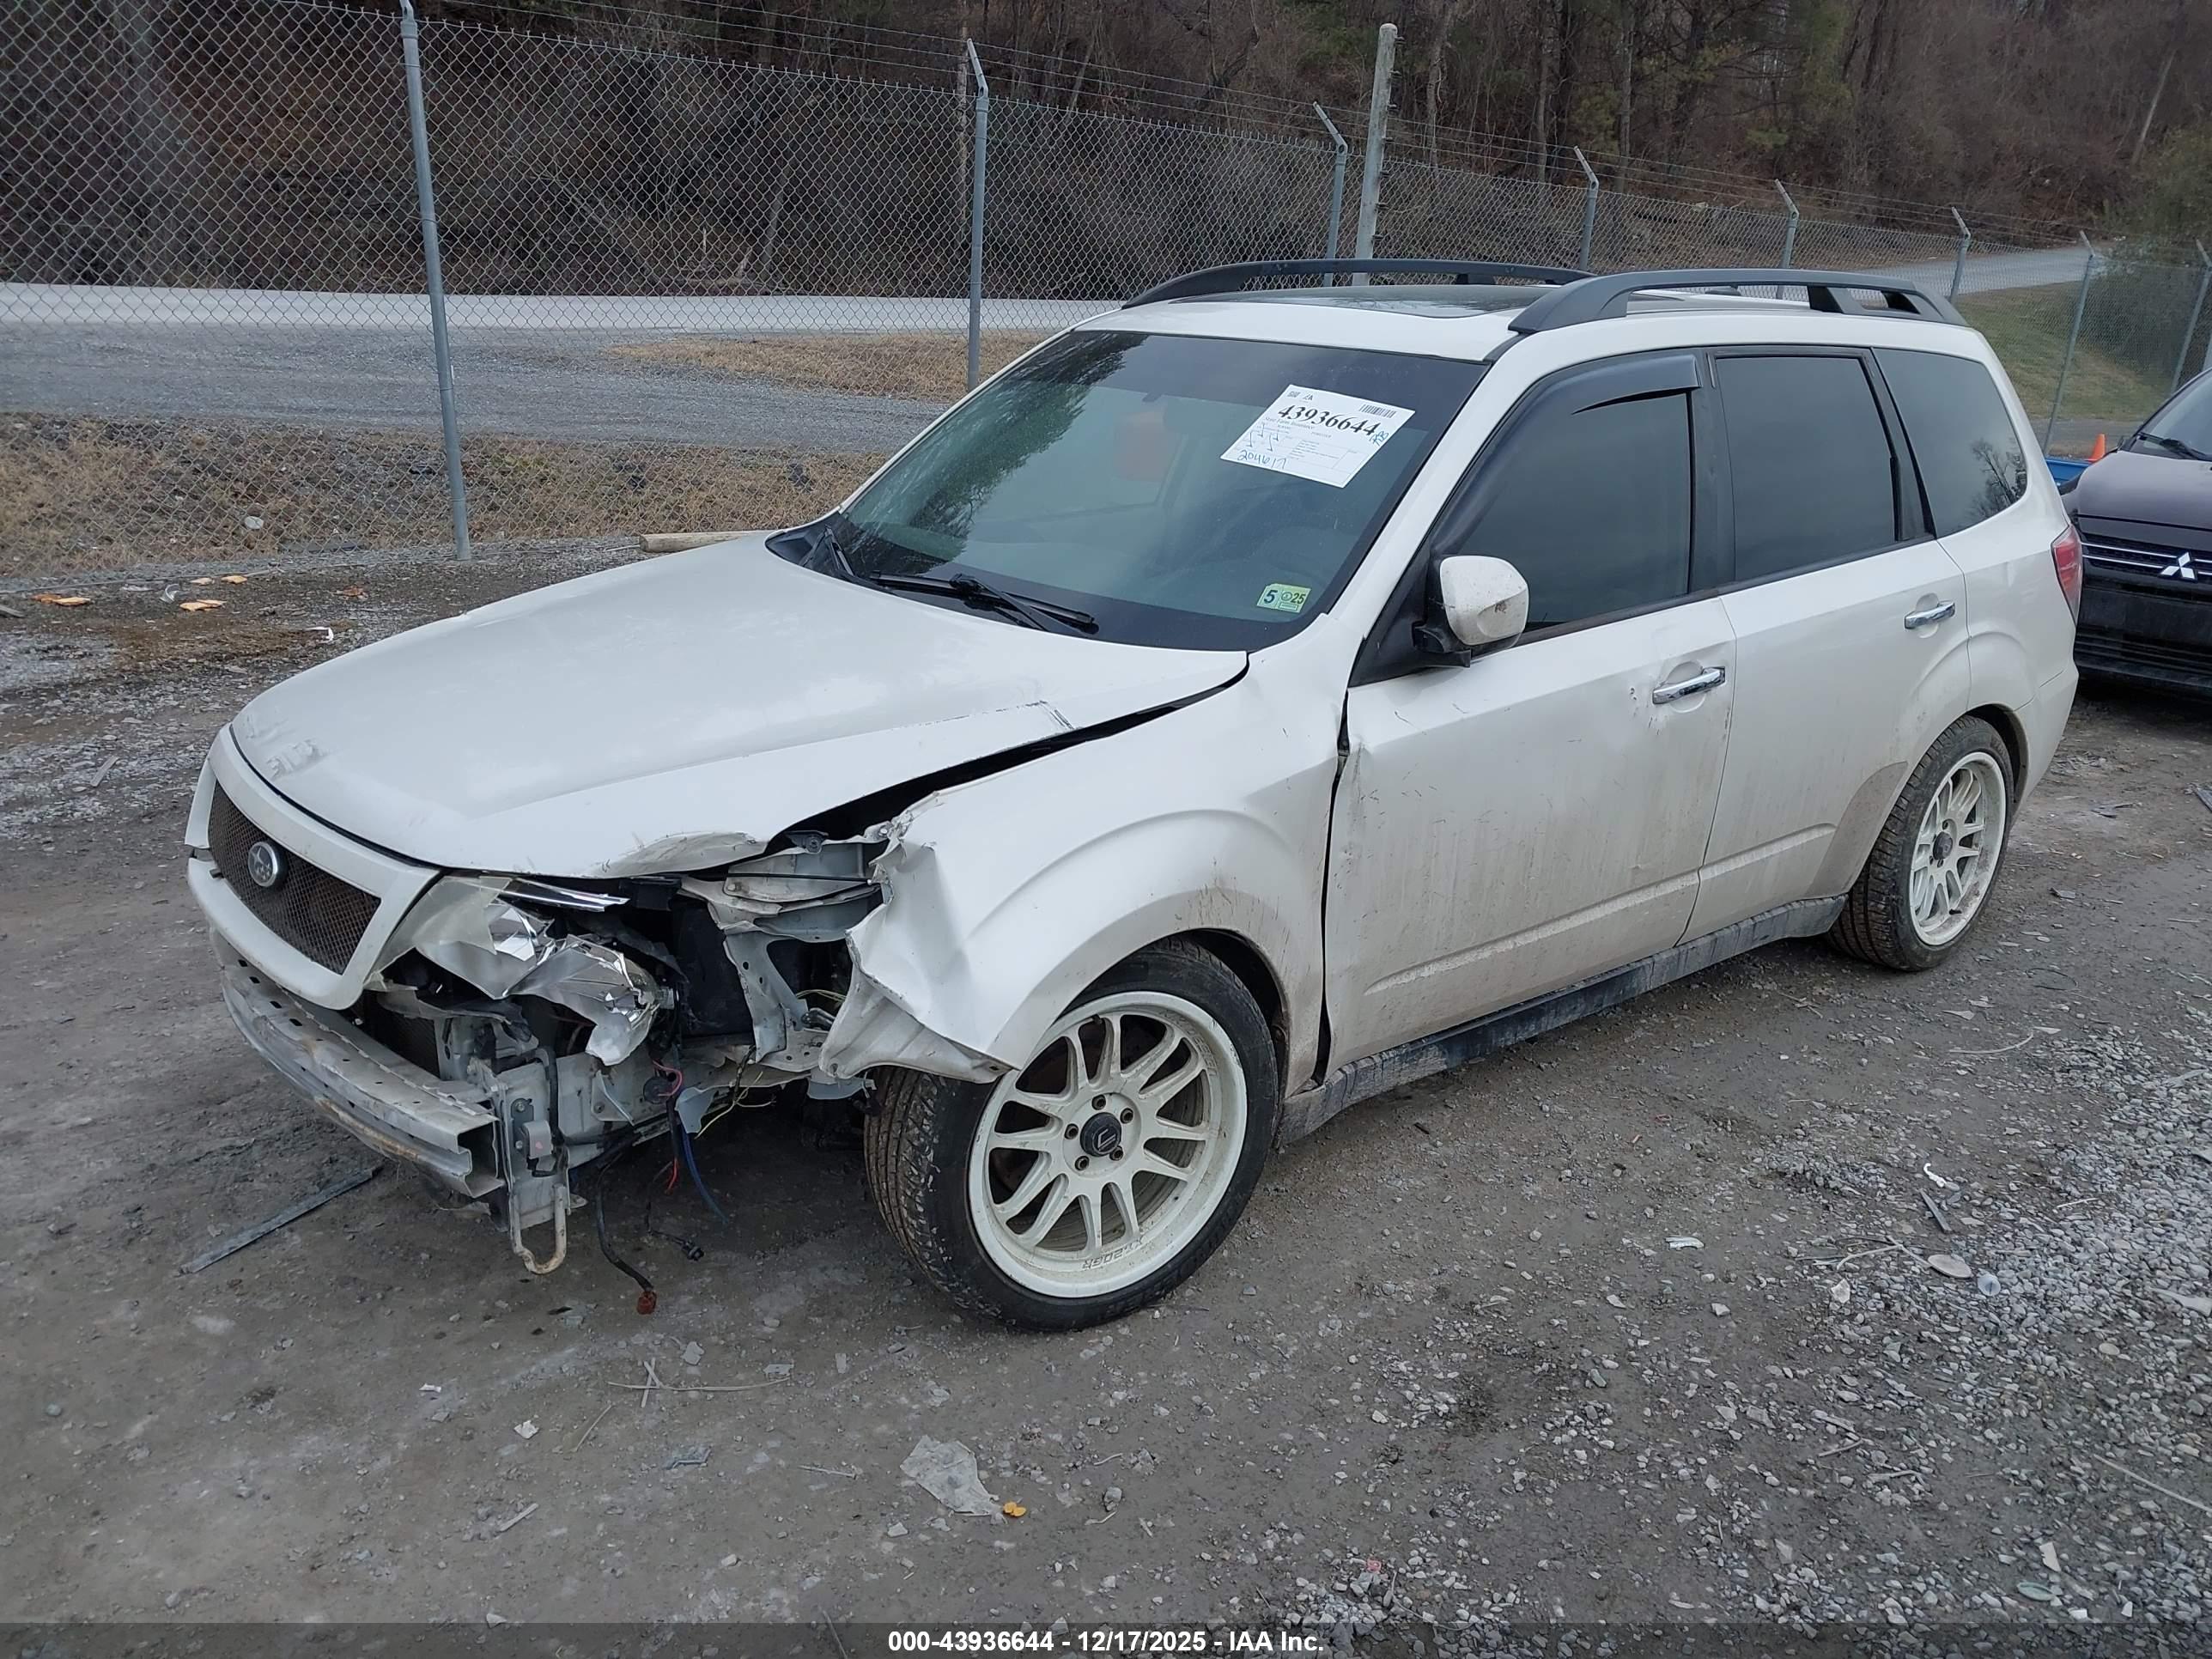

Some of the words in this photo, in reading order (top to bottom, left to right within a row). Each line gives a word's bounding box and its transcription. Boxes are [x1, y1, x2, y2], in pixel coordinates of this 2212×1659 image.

[1278, 404, 1381, 435] 43936644
[1264, 590, 1278, 604] 5
[1291, 592, 1306, 605] 25
